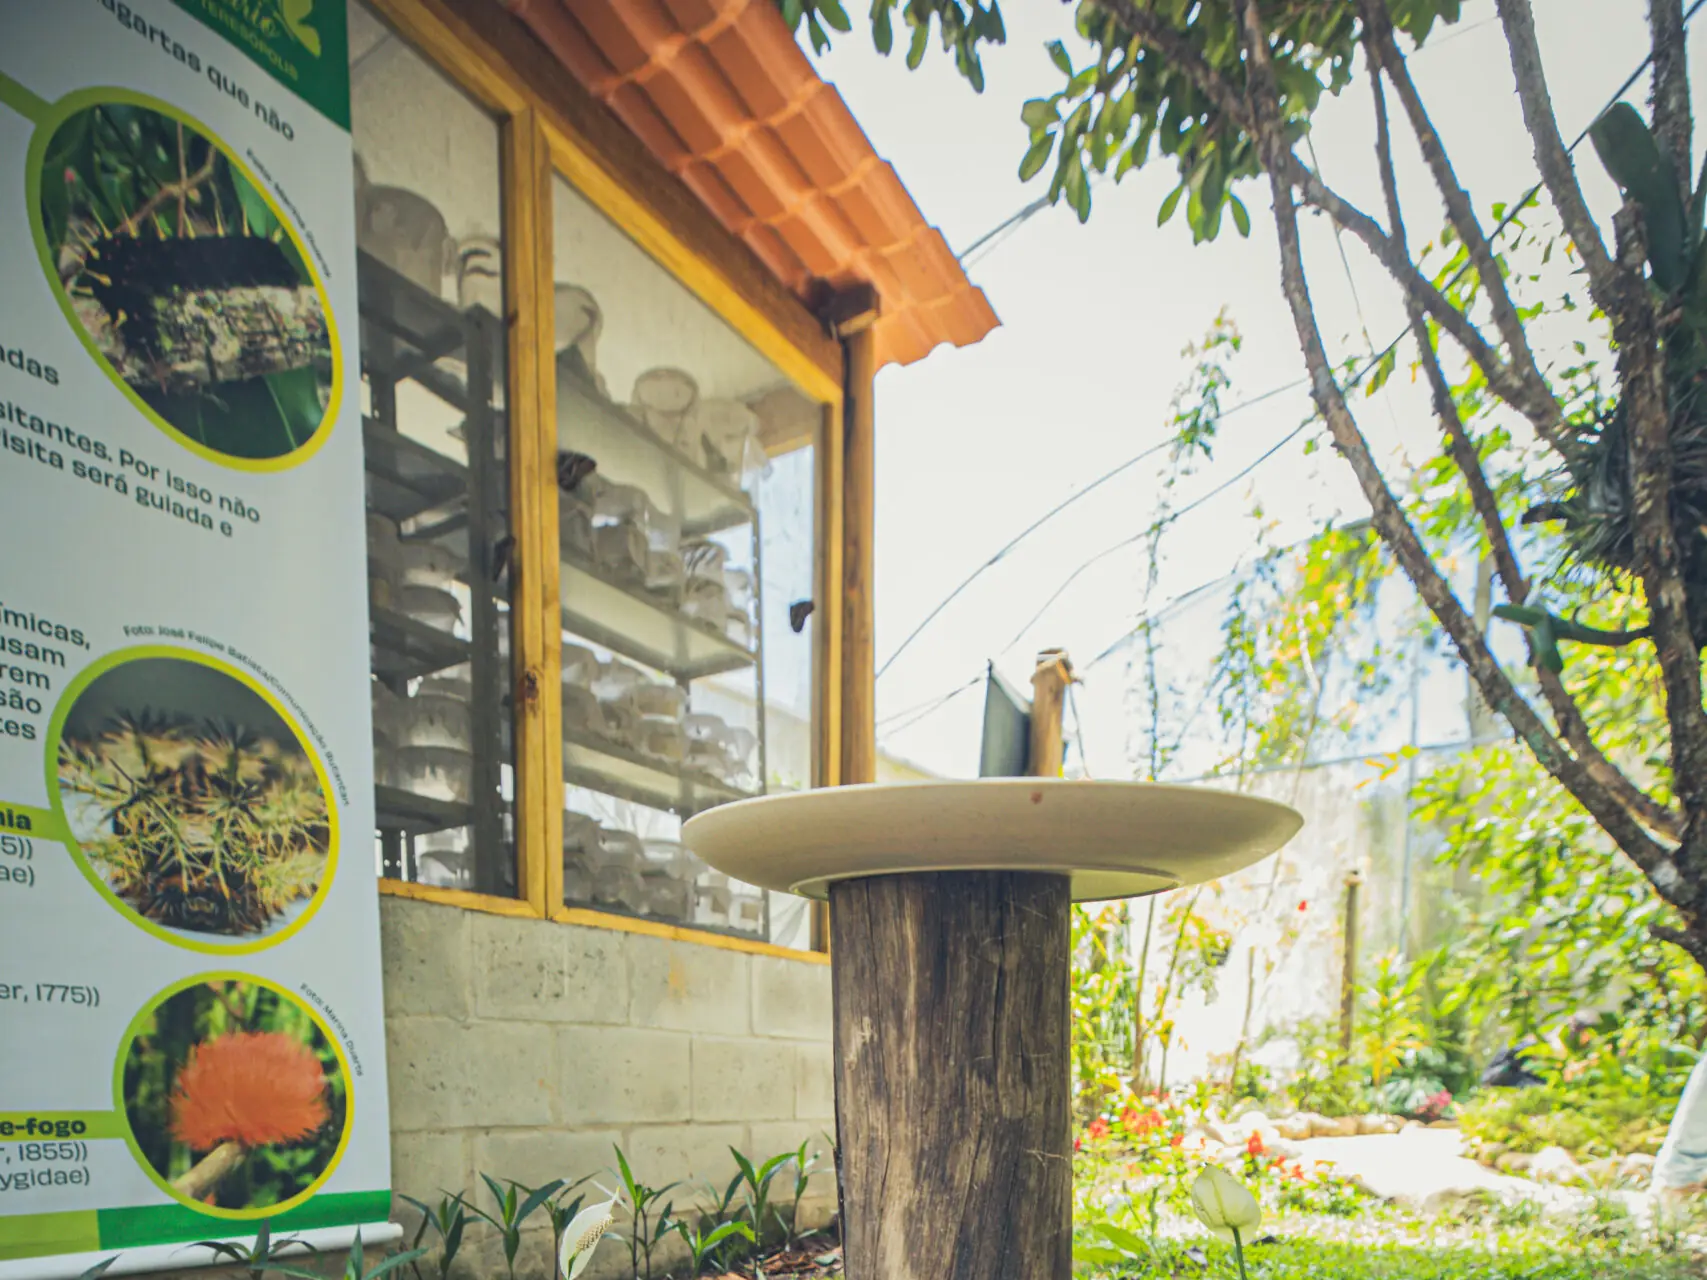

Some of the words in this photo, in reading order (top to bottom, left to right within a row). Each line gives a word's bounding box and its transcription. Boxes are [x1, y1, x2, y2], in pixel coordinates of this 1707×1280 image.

[96, 0, 201, 73] agartas
[207, 64, 250, 110] que
[254, 103, 294, 141] não
[0, 427, 64, 470] isita
[72, 459, 128, 495] será
[135, 485, 214, 531] guiada
[219, 520, 233, 538] e
[119, 447, 160, 481] Por
[165, 468, 213, 504] isso
[218, 495, 260, 523] não
[0, 600, 90, 651] micas,
[36, 983, 100, 1007] 1775))
[18, 1141, 88, 1163] 1855))
